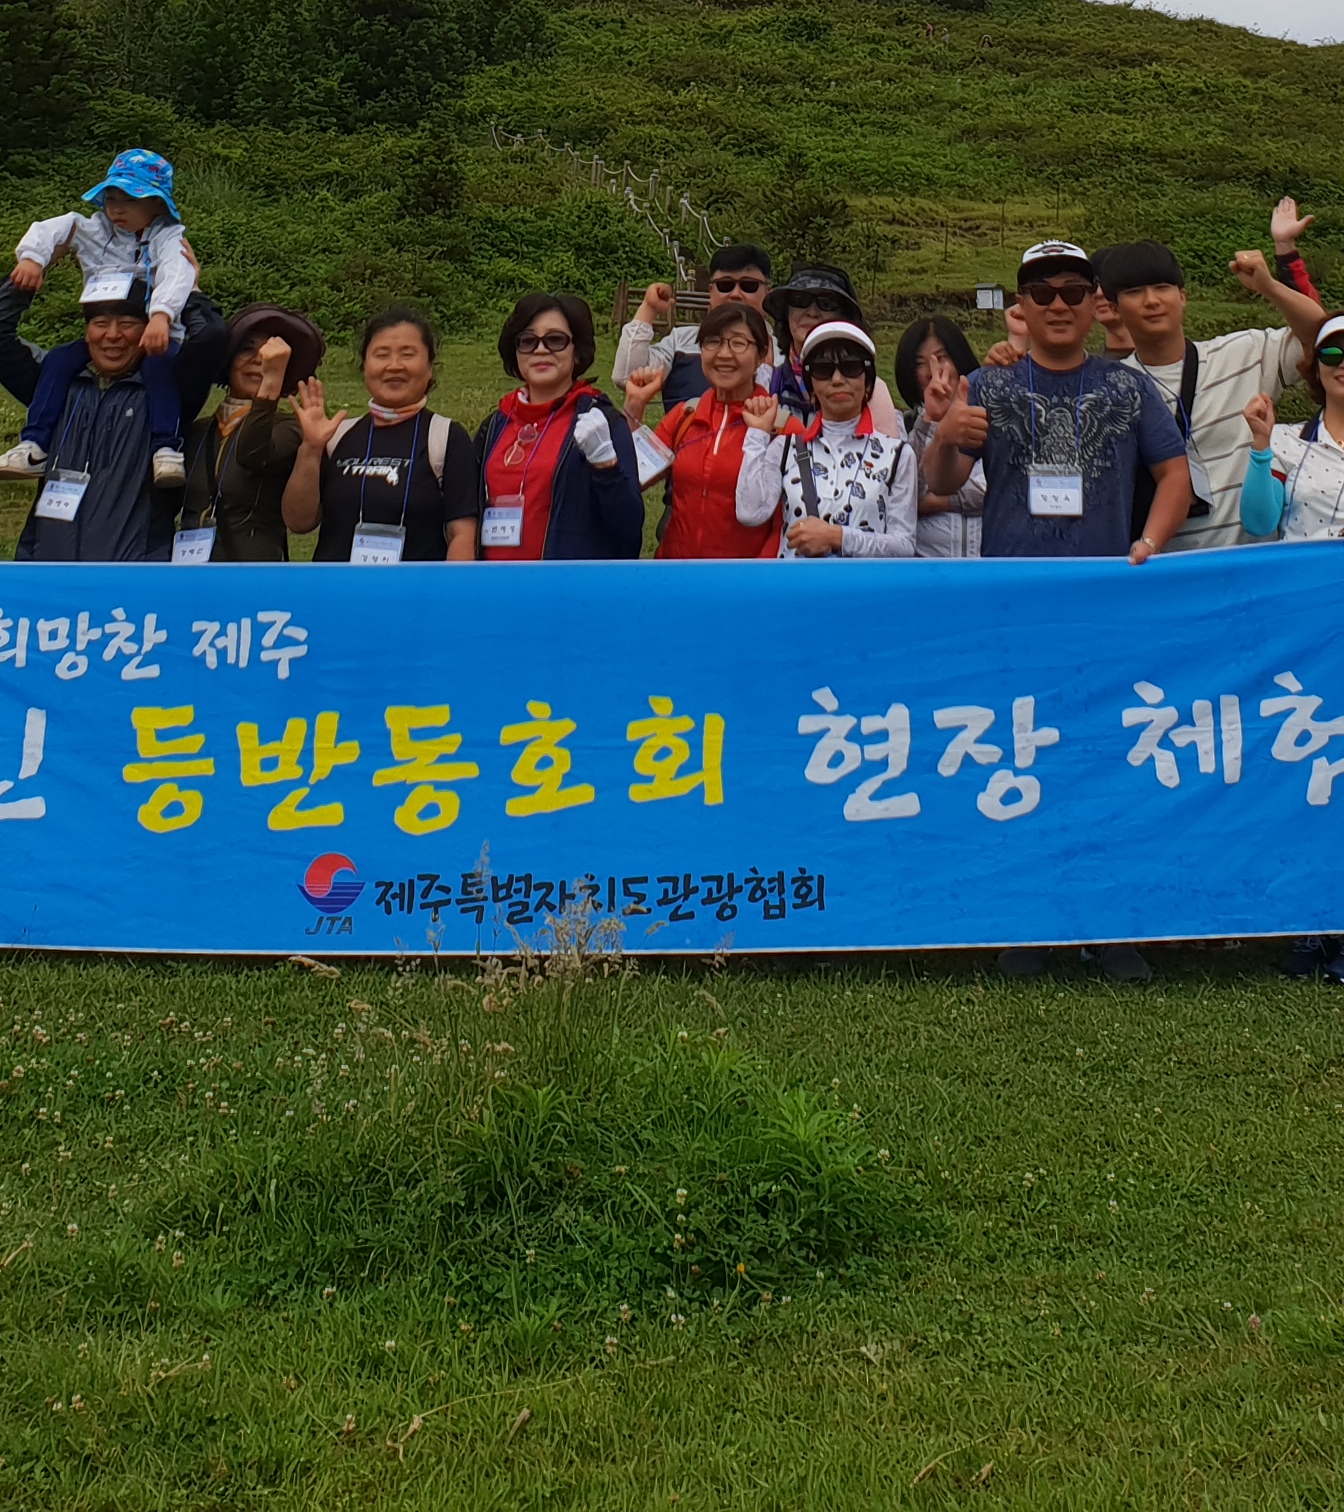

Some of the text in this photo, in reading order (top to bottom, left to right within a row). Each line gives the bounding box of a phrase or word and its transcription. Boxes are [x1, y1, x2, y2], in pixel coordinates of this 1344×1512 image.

[192, 611, 309, 680] 제주
[123, 696, 725, 835] 등반동호회
[797, 686, 1060, 822] 현장
[304, 915, 354, 936] JTA
[374, 865, 826, 925] 제주특별자치도관광협회
